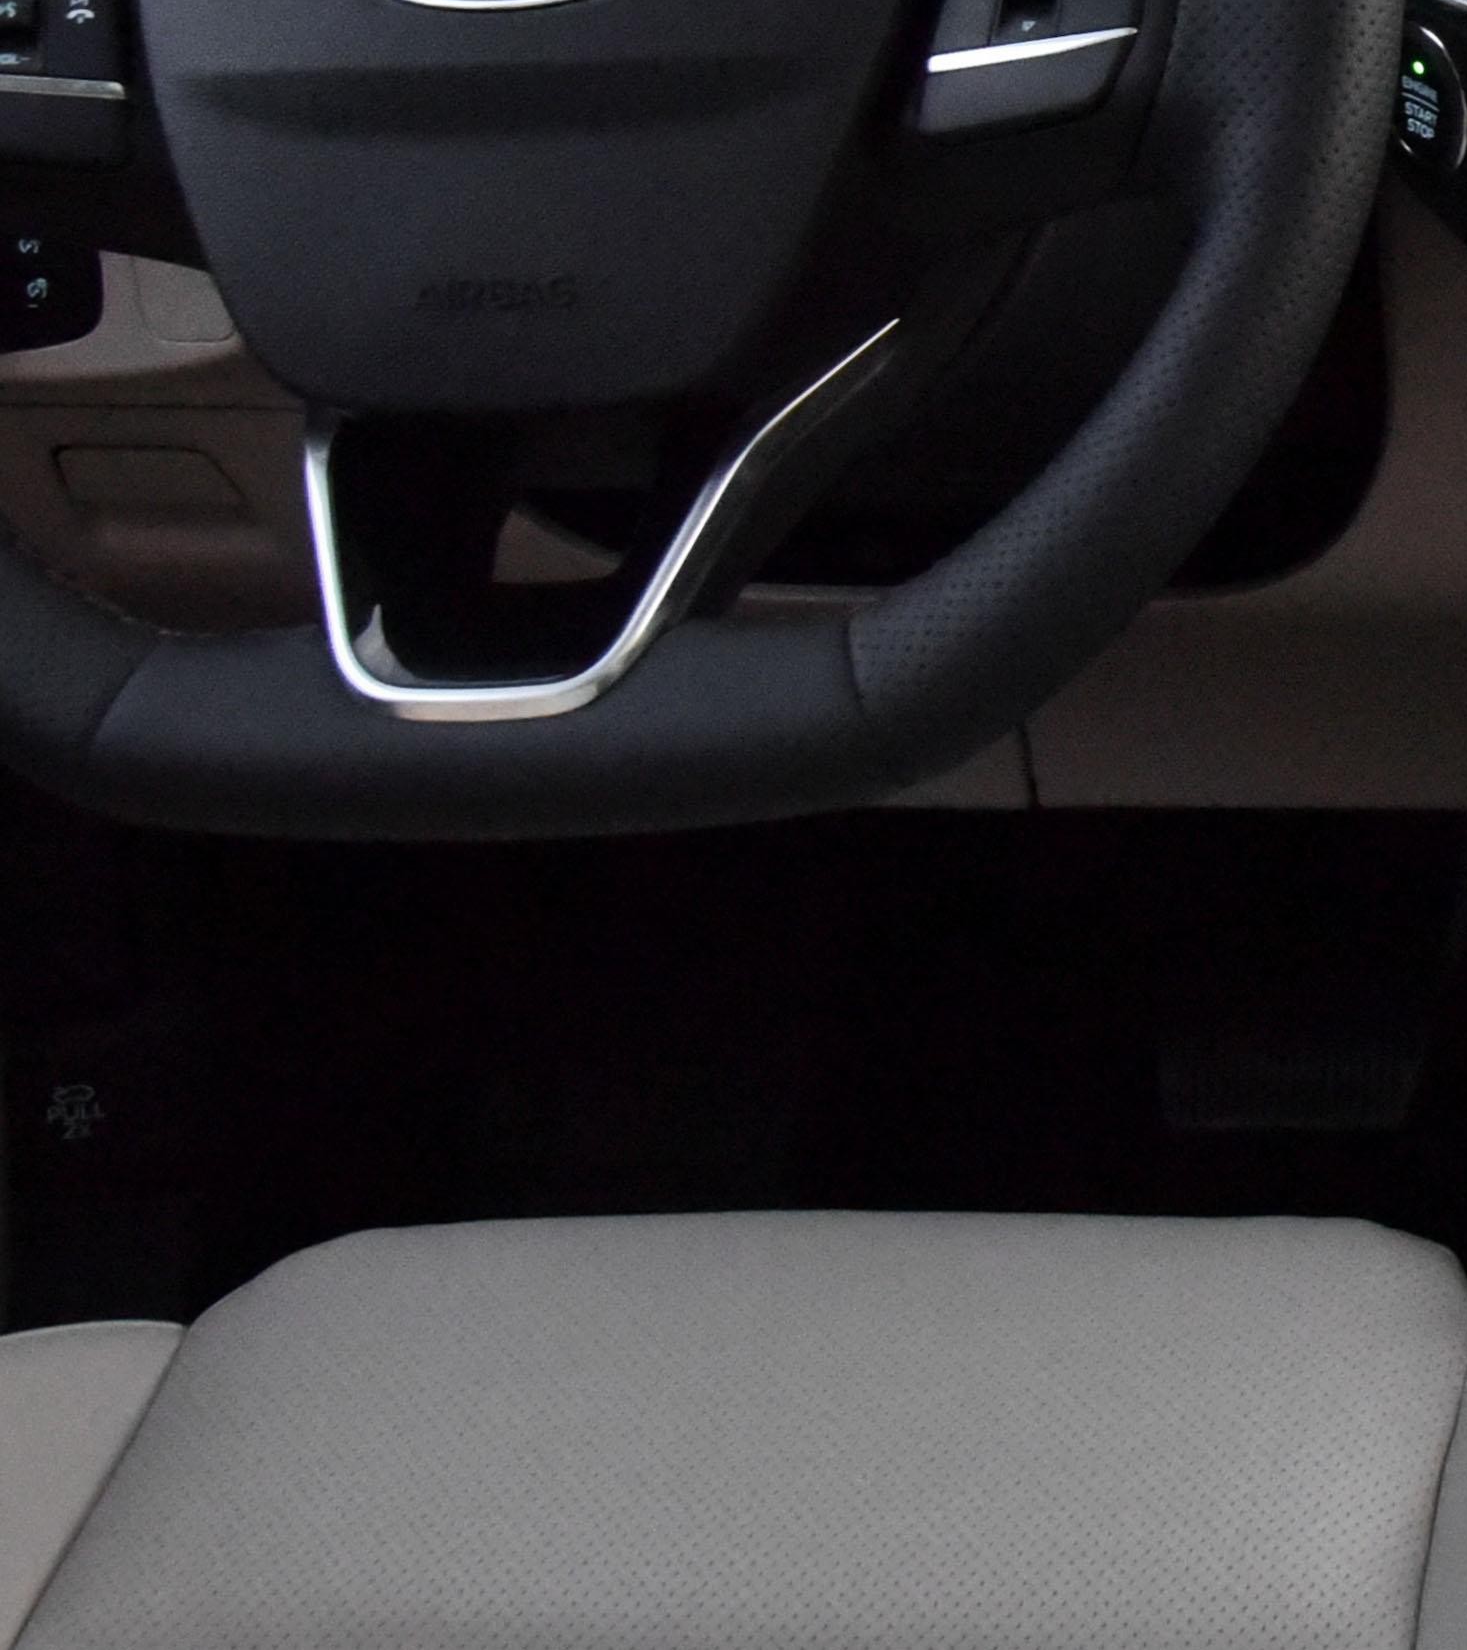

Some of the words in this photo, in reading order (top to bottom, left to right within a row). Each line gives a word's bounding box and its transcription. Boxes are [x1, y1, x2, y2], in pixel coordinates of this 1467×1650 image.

[1402, 75, 1438, 103] ENGINE
[1405, 101, 1437, 129] START
[1407, 118, 1435, 139] STOP
[47, 1099, 105, 1125] PULL
